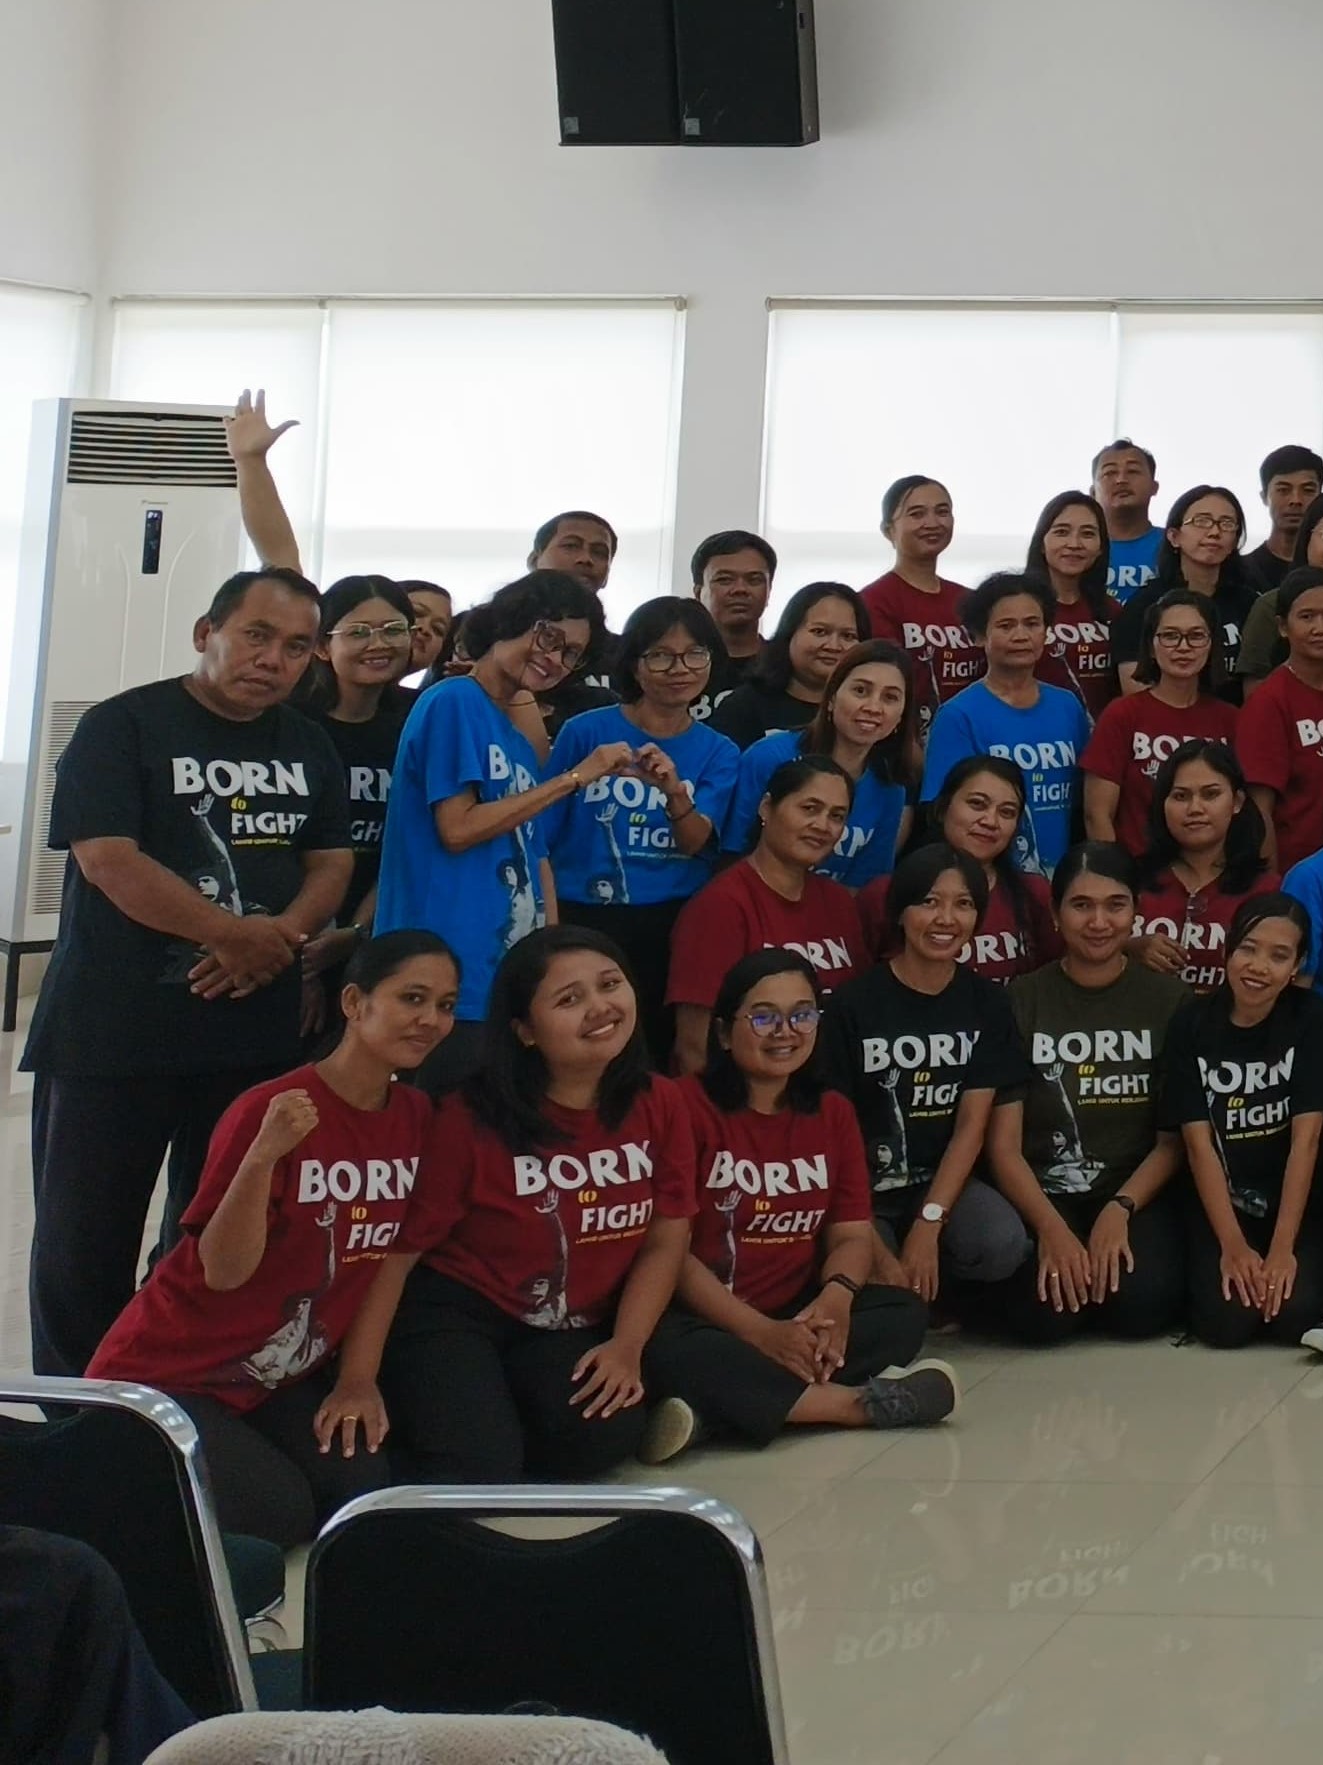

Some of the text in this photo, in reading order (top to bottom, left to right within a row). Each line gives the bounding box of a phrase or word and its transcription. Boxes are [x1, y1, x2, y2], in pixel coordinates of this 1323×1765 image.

[943, 661, 980, 677] FIGH
[1078, 648, 1112, 669] FIG
[171, 757, 310, 797] BORN
[350, 767, 393, 803] RN
[1033, 773, 1044, 783] to
[230, 797, 247, 811] to
[1032, 783, 1071, 803] FIGH
[629, 812, 647, 824] to
[628, 827, 678, 849] FIG
[862, 1030, 981, 1074] BORN
[1032, 1028, 1153, 1064] BORN
[914, 1071, 931, 1084] to
[1078, 1063, 1095, 1076] to
[1197, 1046, 1296, 1094] BORN
[1079, 1073, 1151, 1096] FIGHT
[1226, 1096, 1292, 1130] FIGHT
[1227, 1095, 1245, 1109] to
[297, 1156, 420, 1203] BORN
[512, 1140, 654, 1197] BORN
[705, 1150, 830, 1197] BORN
[577, 1190, 598, 1204] to
[755, 1199, 771, 1212] to
[351, 1206, 368, 1221] to
[580, 1199, 654, 1233] FIGHT
[746, 1209, 826, 1233] FIGHT
[346, 1221, 401, 1250] FIG
